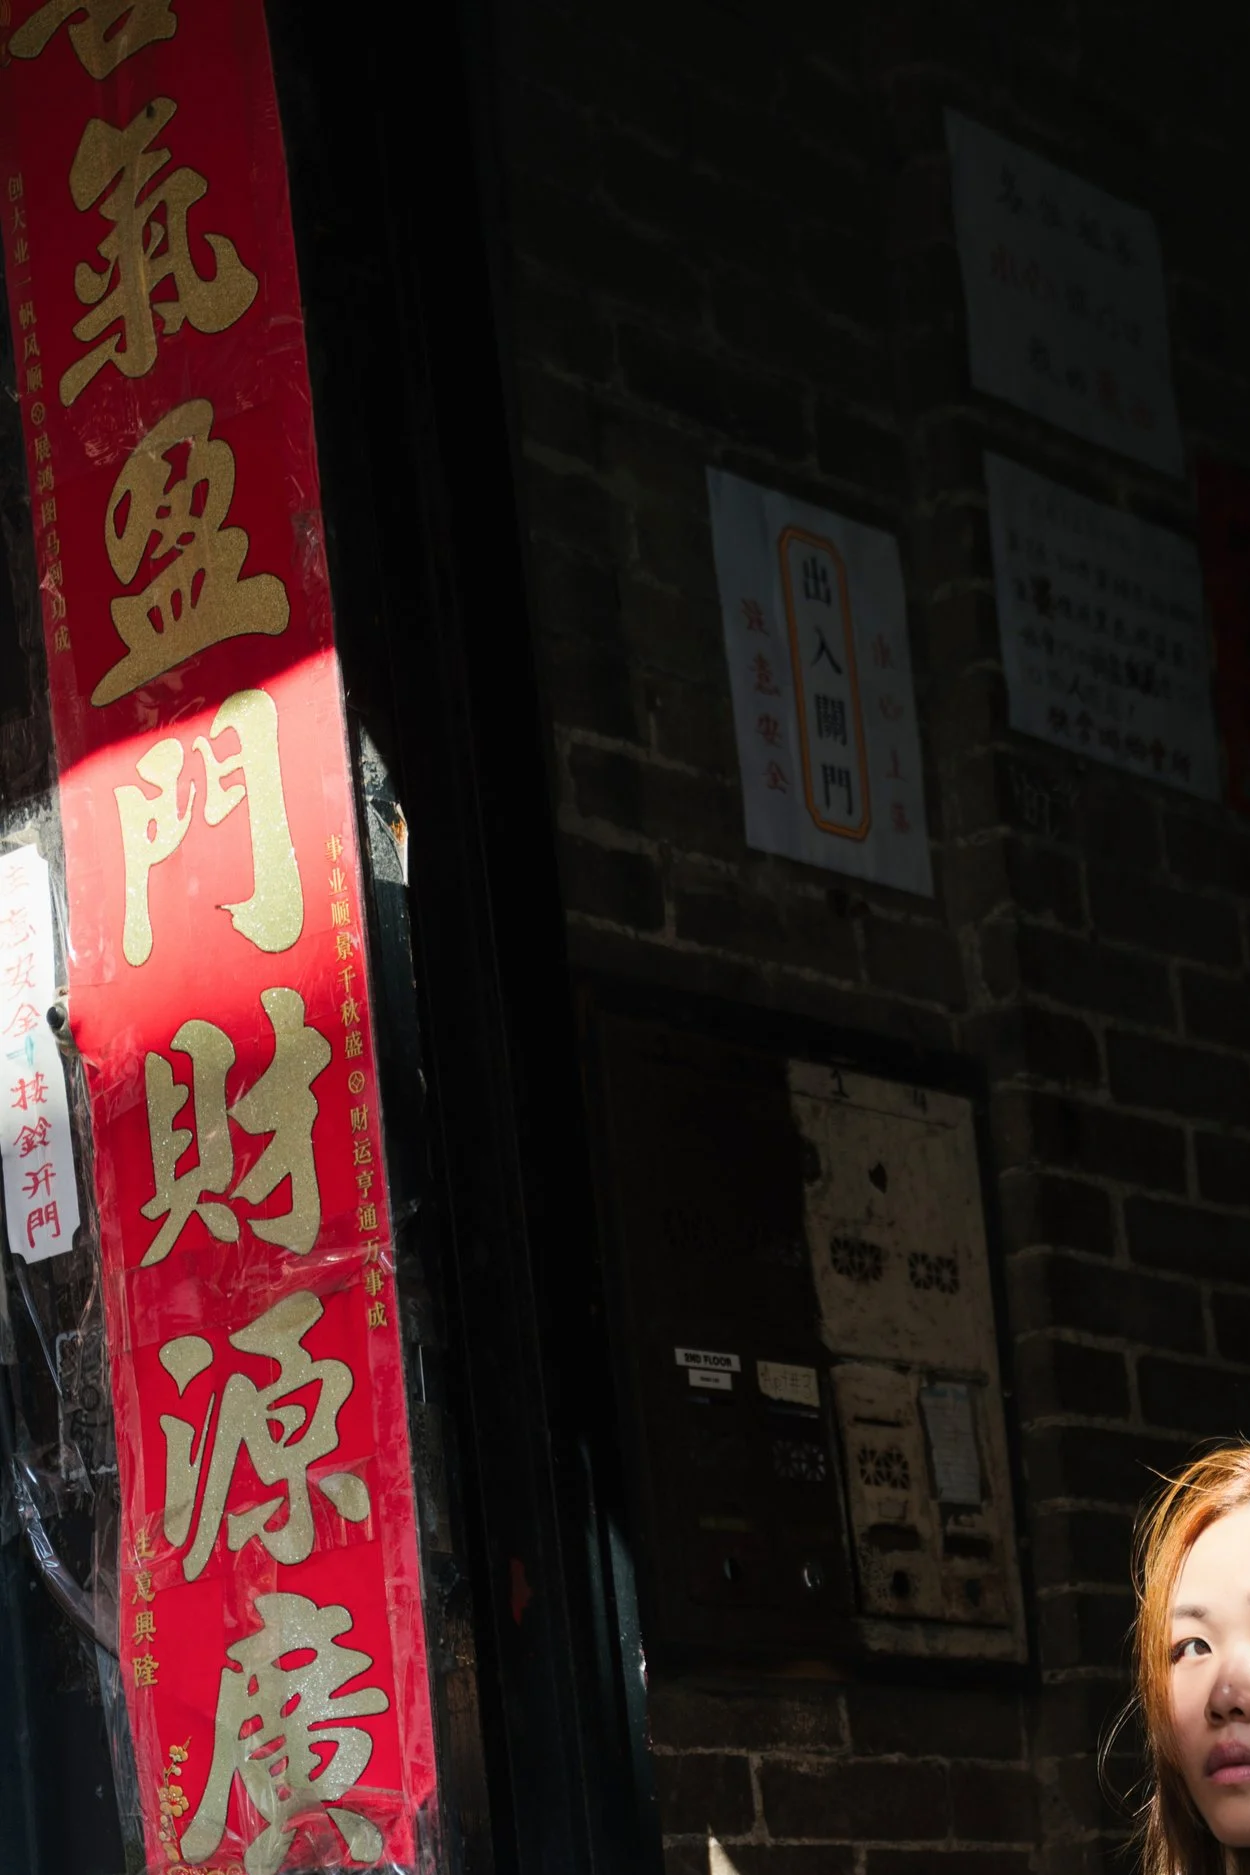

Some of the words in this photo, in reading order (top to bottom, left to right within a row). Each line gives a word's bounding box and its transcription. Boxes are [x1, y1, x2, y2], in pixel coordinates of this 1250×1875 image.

[8, 172, 44, 394] 创大业一帆风顺
[802, 555, 854, 817] 出入關門
[324, 833, 364, 1060] 事业顺景千秋盛
[350, 1103, 388, 1330] 财运亨通万事成
[703, 1354, 732, 1368] FLOOR
[131, 1528, 159, 1688] 生意興隆
